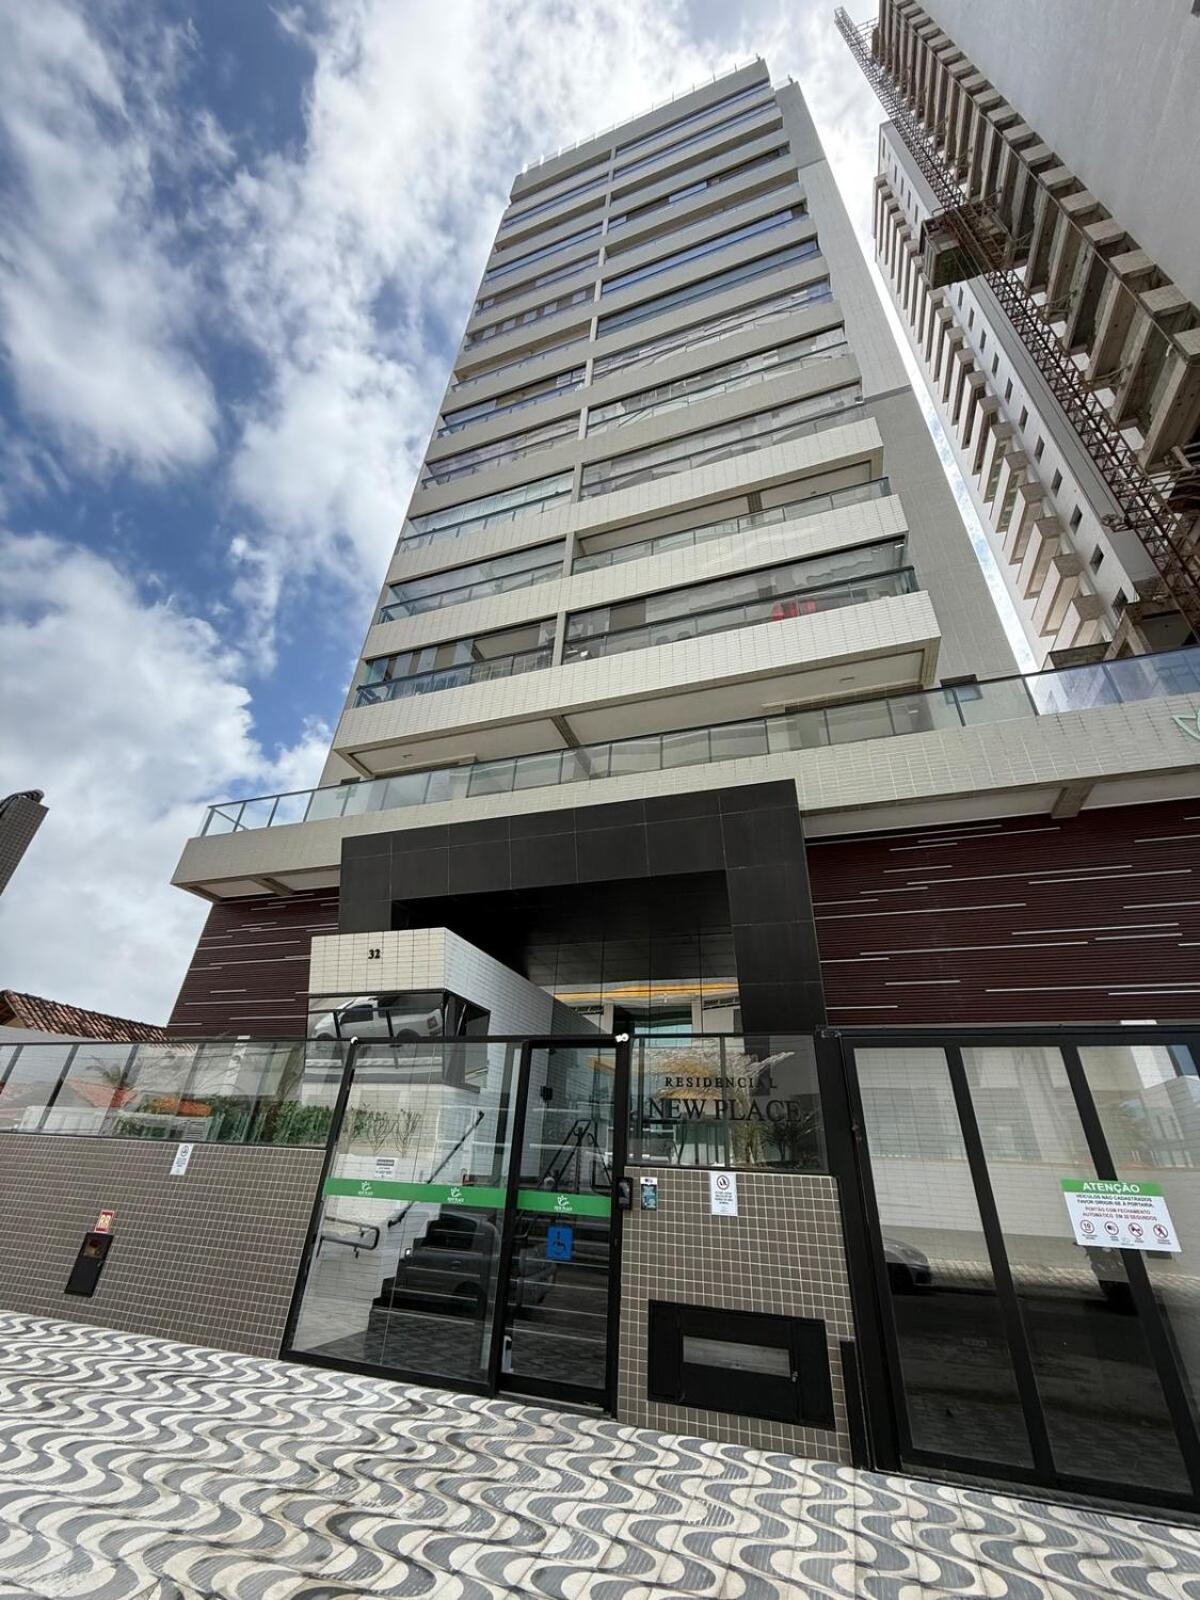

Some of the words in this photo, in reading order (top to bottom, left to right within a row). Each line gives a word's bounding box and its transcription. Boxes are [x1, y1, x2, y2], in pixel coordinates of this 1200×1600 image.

[367, 948, 381, 960] 32
[664, 1076, 778, 1089] RESIDENCIAL
[648, 1098, 706, 1121] NEW
[714, 1099, 801, 1122] PLACE
[1082, 1182, 1140, 1193] ATENÇÃO
